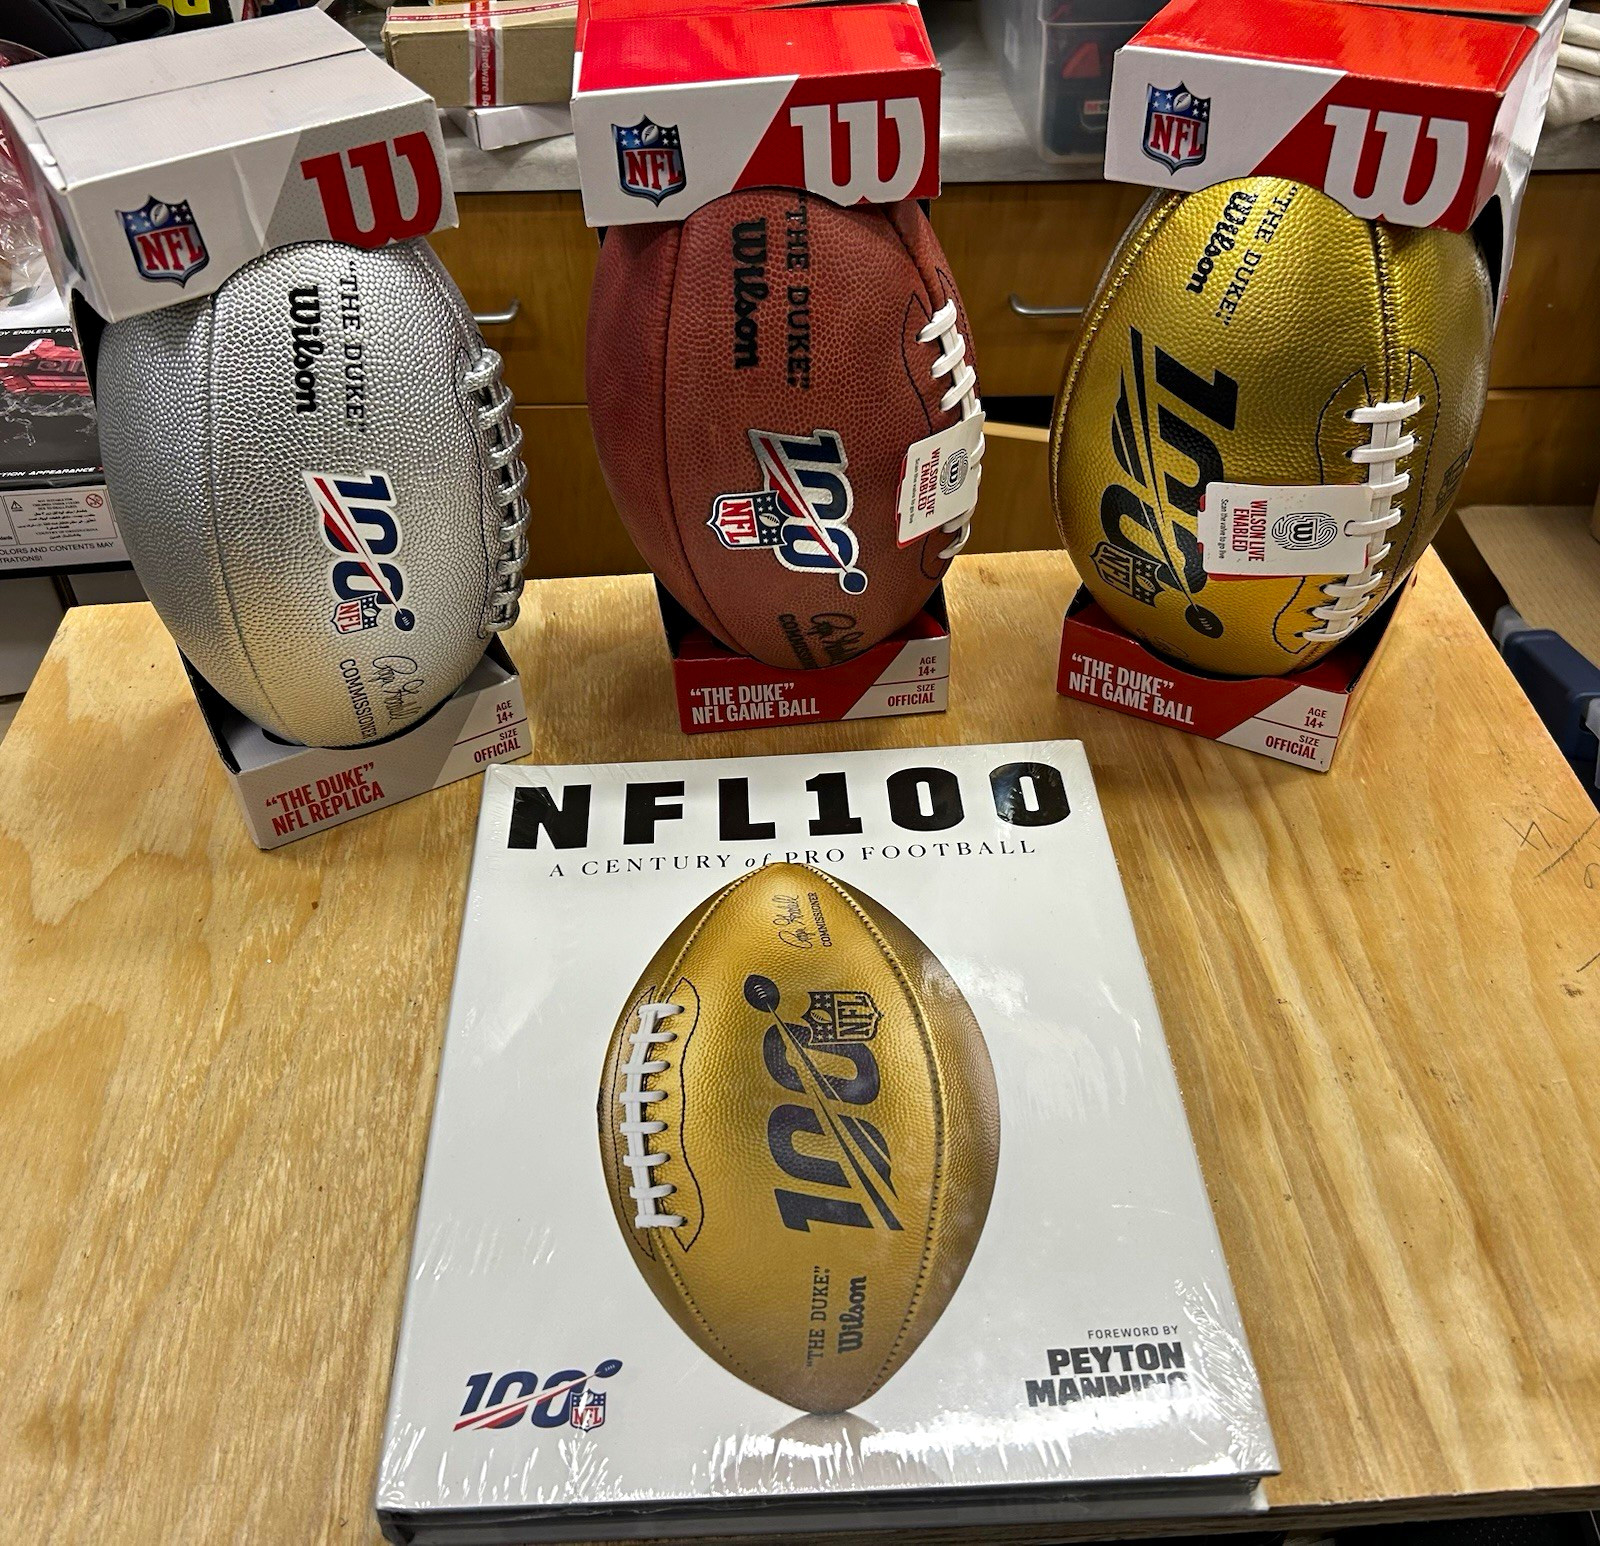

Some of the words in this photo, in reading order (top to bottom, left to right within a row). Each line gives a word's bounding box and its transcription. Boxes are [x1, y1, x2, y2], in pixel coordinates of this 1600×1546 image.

[482, 45, 491, 92] Hardware
[1150, 114, 1204, 157] NFL
[624, 149, 683, 190] NFL
[137, 227, 205, 271] NFL
[1186, 190, 1260, 294] Wilson
[731, 216, 769, 370] Wilson
[289, 285, 325, 414] Wilson
[28, 466, 96, 476] APPEARANCE
[918, 461, 931, 511] ENABLED
[927, 447, 941, 492] WILSON
[766, 435, 853, 569] 100
[925, 492, 937, 518] LIVE
[1220, 498, 1229, 512] Scan
[1220, 513, 1228, 521] the
[1249, 500, 1268, 539] WILSON
[318, 473, 404, 605] 100
[721, 500, 760, 544] NFL
[1232, 508, 1250, 552] ENABLED
[49, 542, 96, 552] CONTENTS
[97, 541, 115, 549] MAY
[1248, 541, 1265, 561] LIVE
[1098, 547, 1131, 589] NFL
[337, 602, 361, 631] NFL
[918, 665, 936, 677] 14+
[919, 656, 937, 665] AGE
[1071, 652, 1114, 679] "THE
[1116, 666, 1174, 698] DUKE"
[340, 659, 377, 740] COMMISSIONER
[495, 699, 513, 713] AGE
[690, 687, 734, 706] "THE
[738, 682, 795, 703] DUKE"
[887, 692, 936, 708] OFFICIAL
[917, 683, 936, 692] SIZE
[1068, 671, 1099, 697] NFL
[1101, 681, 1149, 712] GAME
[1153, 696, 1195, 725] BALL
[496, 710, 514, 724] 14+
[692, 705, 724, 725] NFL
[726, 702, 777, 722] GAME
[779, 698, 820, 717] BALL
[1303, 716, 1325, 729] 14+
[1307, 706, 1327, 718] AGE
[474, 738, 521, 764] OFFICIAL
[499, 727, 518, 741] SIZE
[1265, 735, 1317, 761] OFFICIAL
[1299, 734, 1320, 747] SIZE
[266, 786, 316, 813] "THE
[315, 761, 375, 796] DUKE"
[271, 810, 309, 837] NFL
[310, 781, 385, 824] REPLICA
[549, 864, 564, 877] A
[581, 854, 732, 876] CENTURY
[744, 852, 772, 868] of
[785, 848, 845, 864] PRO
[861, 840, 1036, 861] FOOTBALL
[807, 892, 832, 947] COMMISSIONER
[838, 995, 867, 1036] NFL
[762, 1022, 890, 1232] 100
[837, 1276, 867, 1354] Wilson
[1088, 1326, 1159, 1340] FOREWORD
[1163, 1325, 1178, 1336] BY
[1047, 1342, 1186, 1376] PEYTON
[455, 1369, 588, 1430] 100
